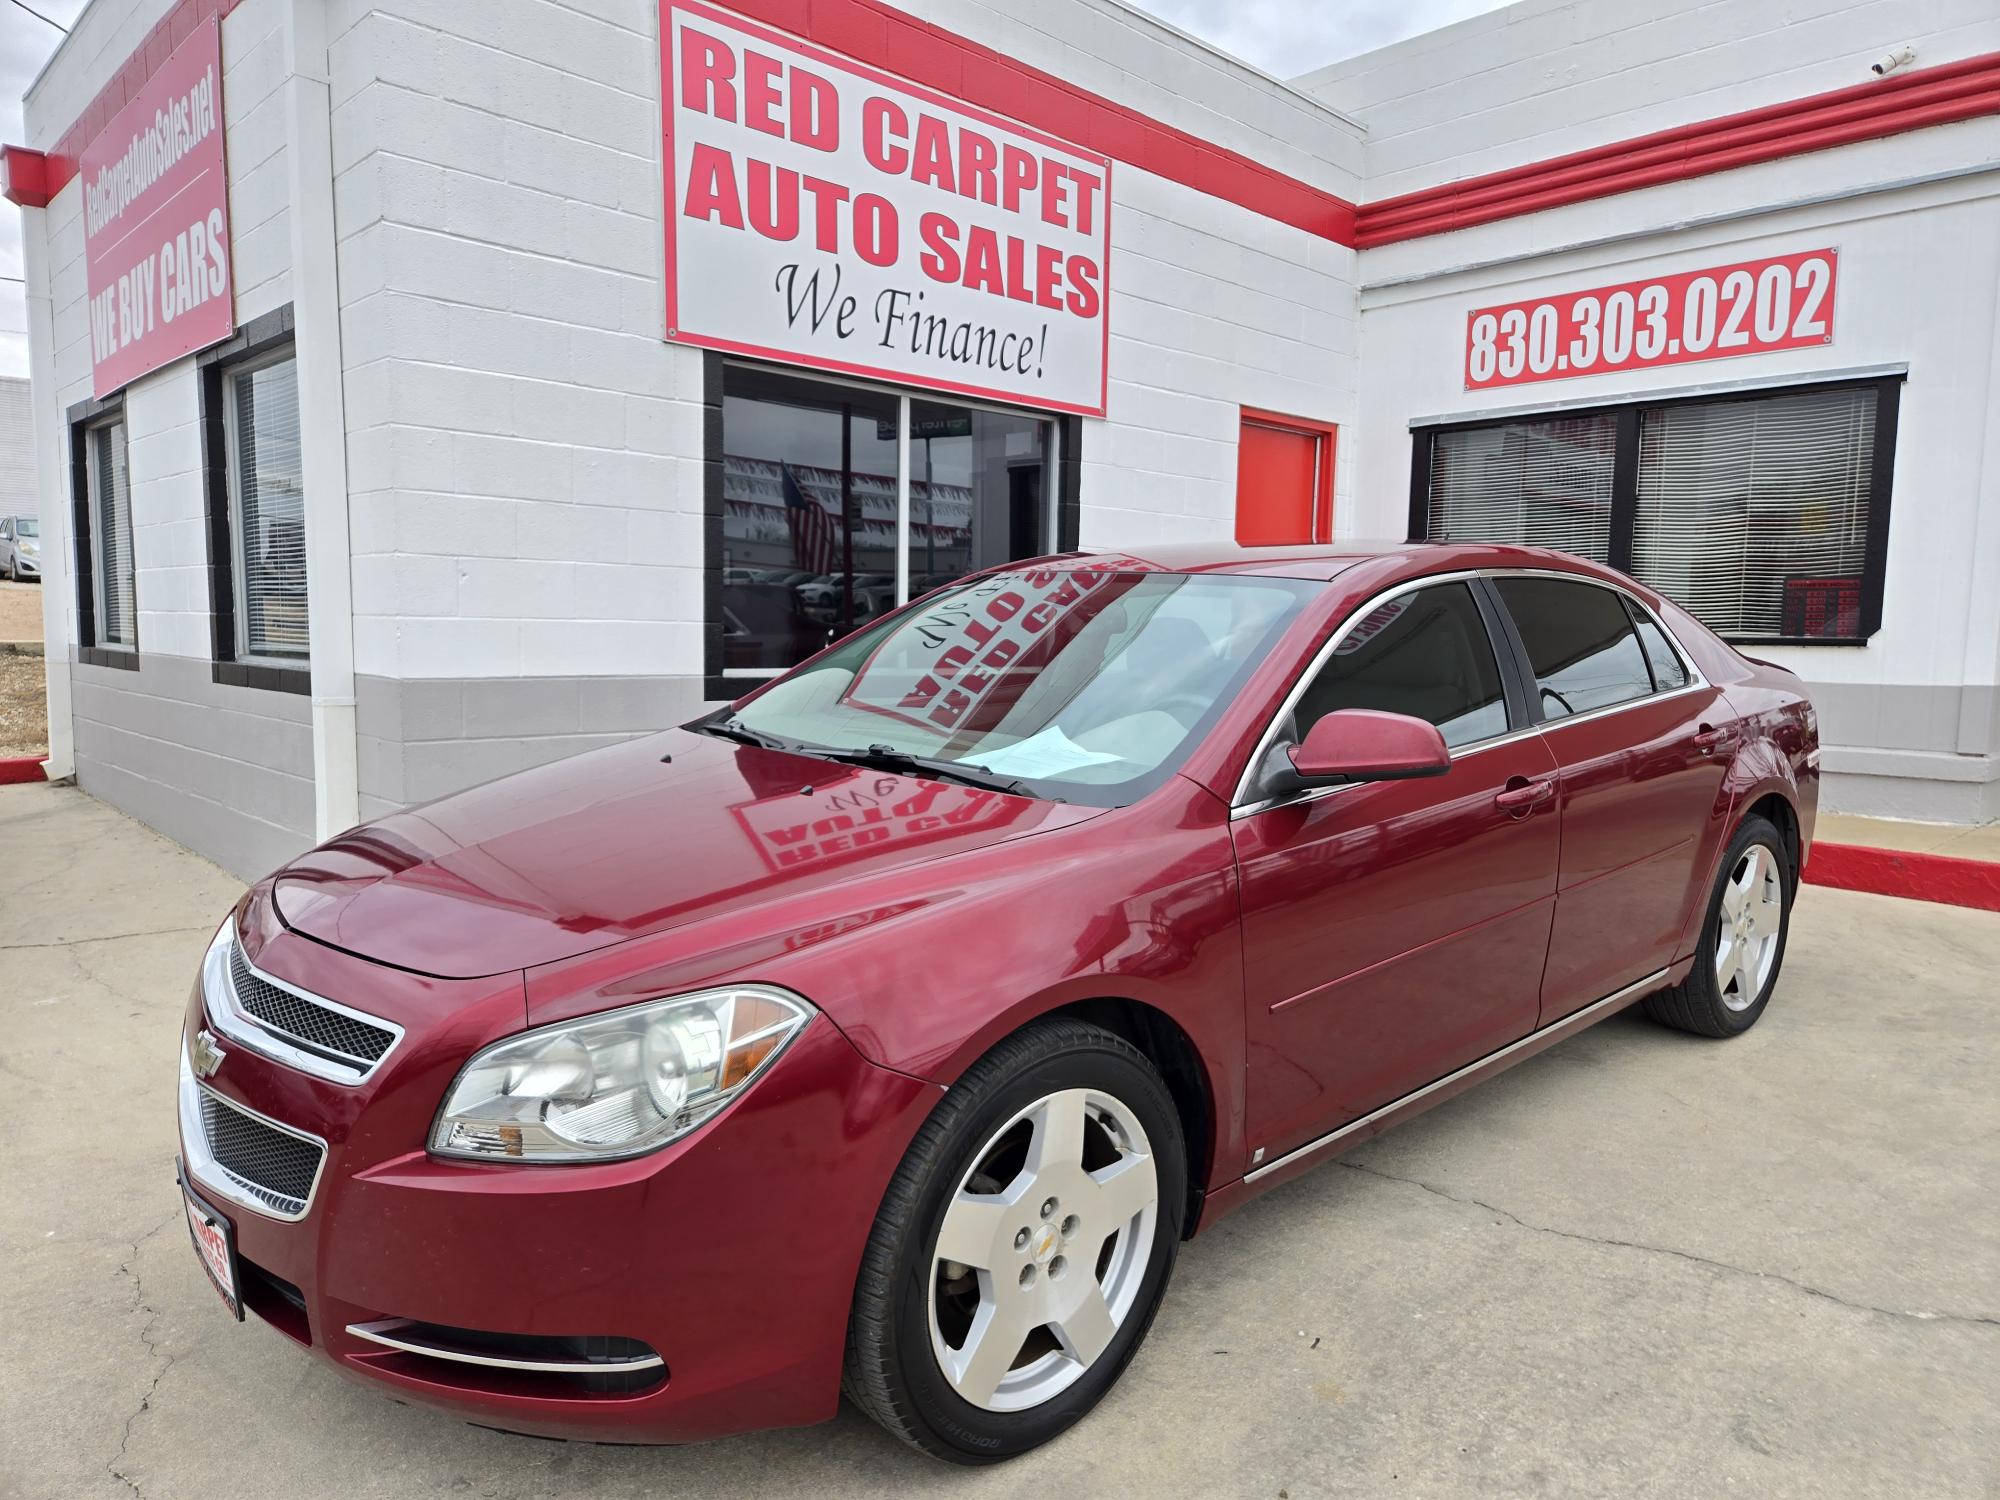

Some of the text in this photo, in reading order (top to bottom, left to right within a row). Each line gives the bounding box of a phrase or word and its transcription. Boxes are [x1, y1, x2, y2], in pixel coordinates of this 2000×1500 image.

[86, 64, 217, 239] RedCarpetAutoSales.net
[680, 25, 1102, 237] RED CARPET
[90, 207, 226, 365] WE BUY CARS
[683, 141, 1100, 319] AUTO SALES
[775, 263, 1048, 379] We Finance!
[1468, 257, 1832, 383] 830.303.0202
